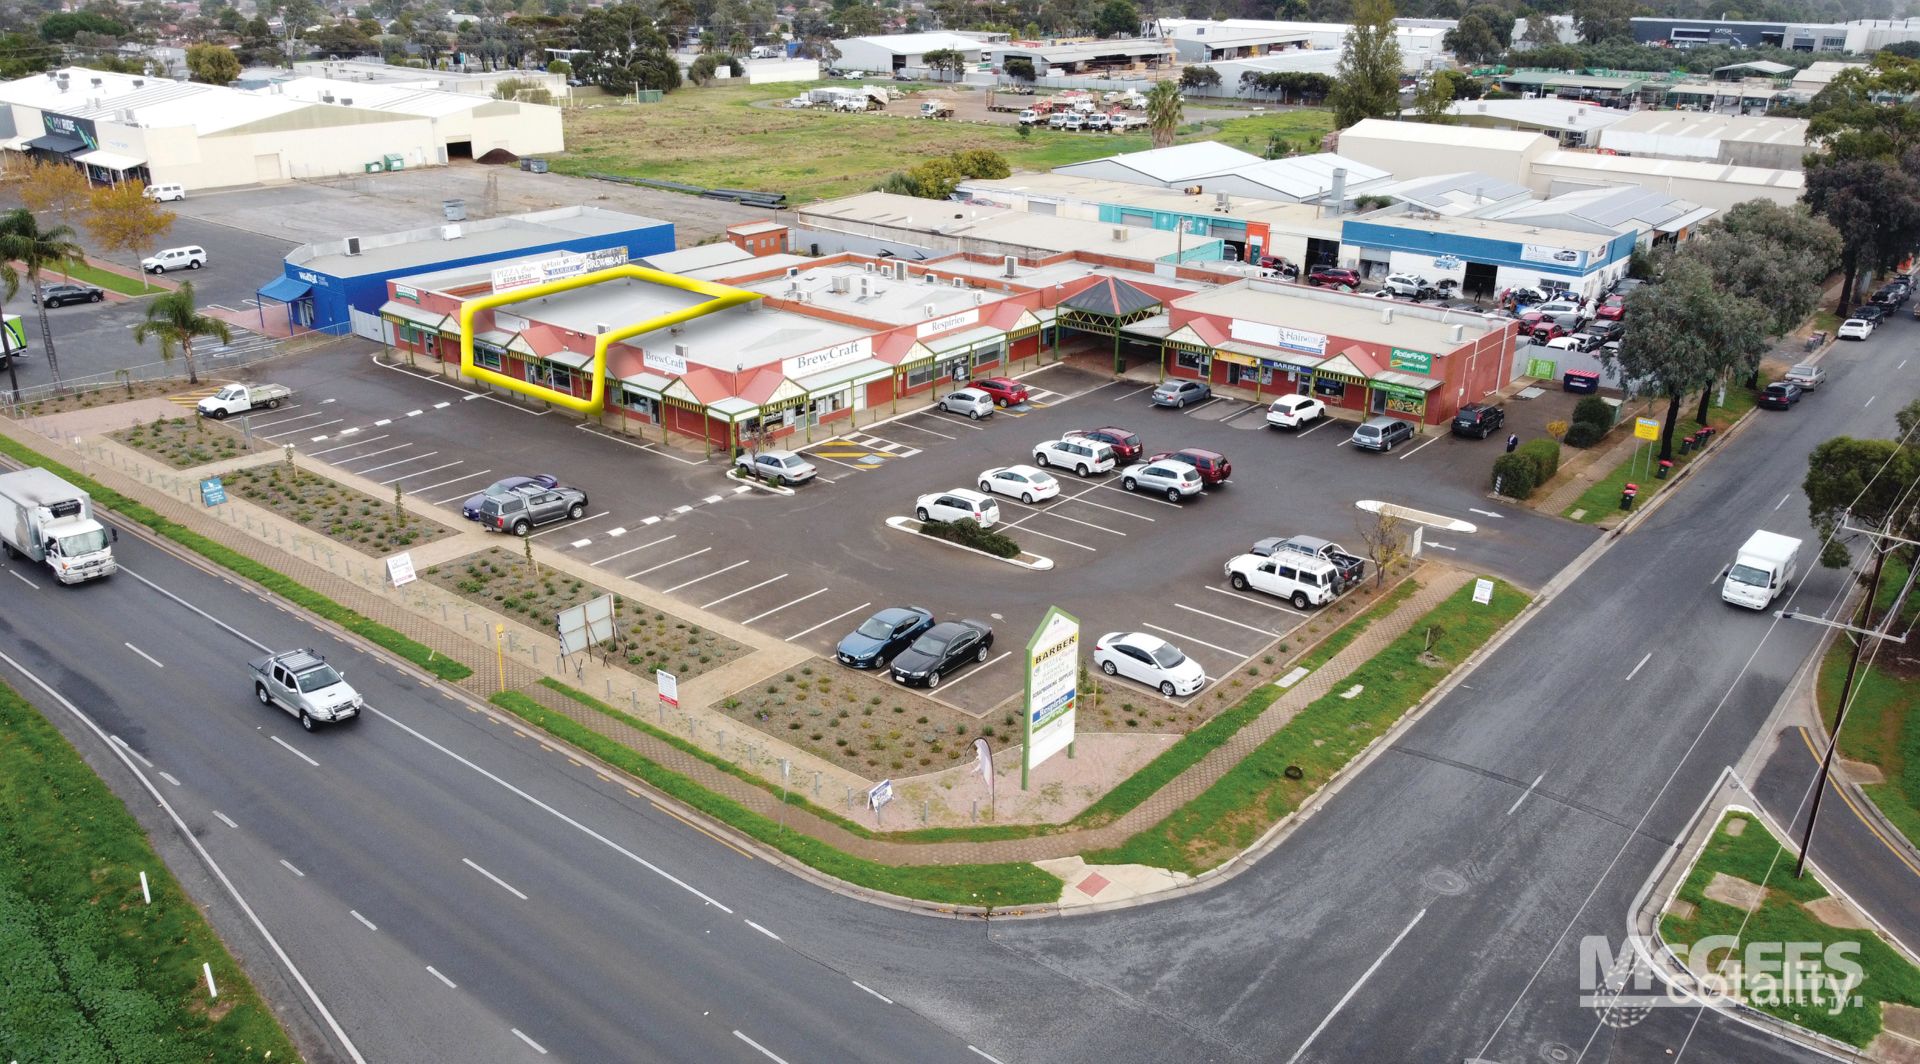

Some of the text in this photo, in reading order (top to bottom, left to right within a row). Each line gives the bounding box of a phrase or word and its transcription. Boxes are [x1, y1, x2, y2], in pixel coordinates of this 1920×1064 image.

[645, 350, 684, 369] BrewCraft
[797, 341, 859, 369] BrewCraft
[1273, 361, 1301, 372] BARBER
[1035, 635, 1075, 664] BARBER
